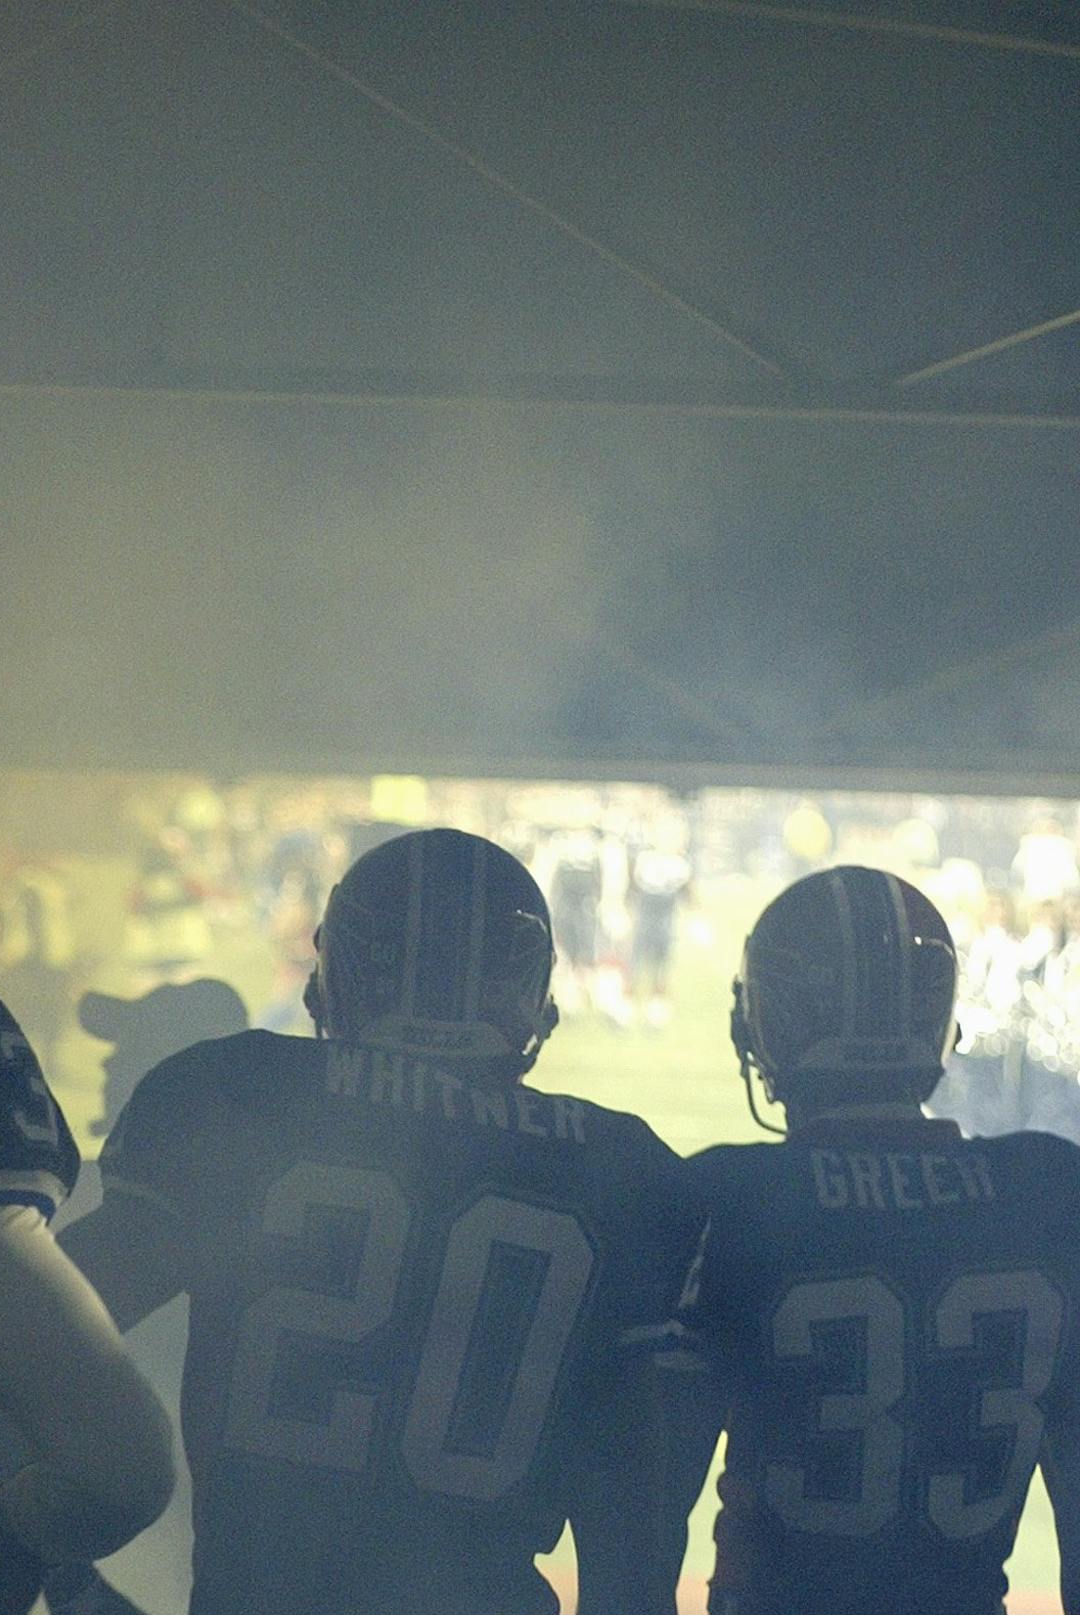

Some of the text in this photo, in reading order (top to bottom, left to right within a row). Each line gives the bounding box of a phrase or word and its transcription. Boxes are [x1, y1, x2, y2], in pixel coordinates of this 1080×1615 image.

[324, 1044, 587, 1143] WHITNER
[230, 1160, 595, 1501] 20
[766, 1269, 1065, 1540] 33
